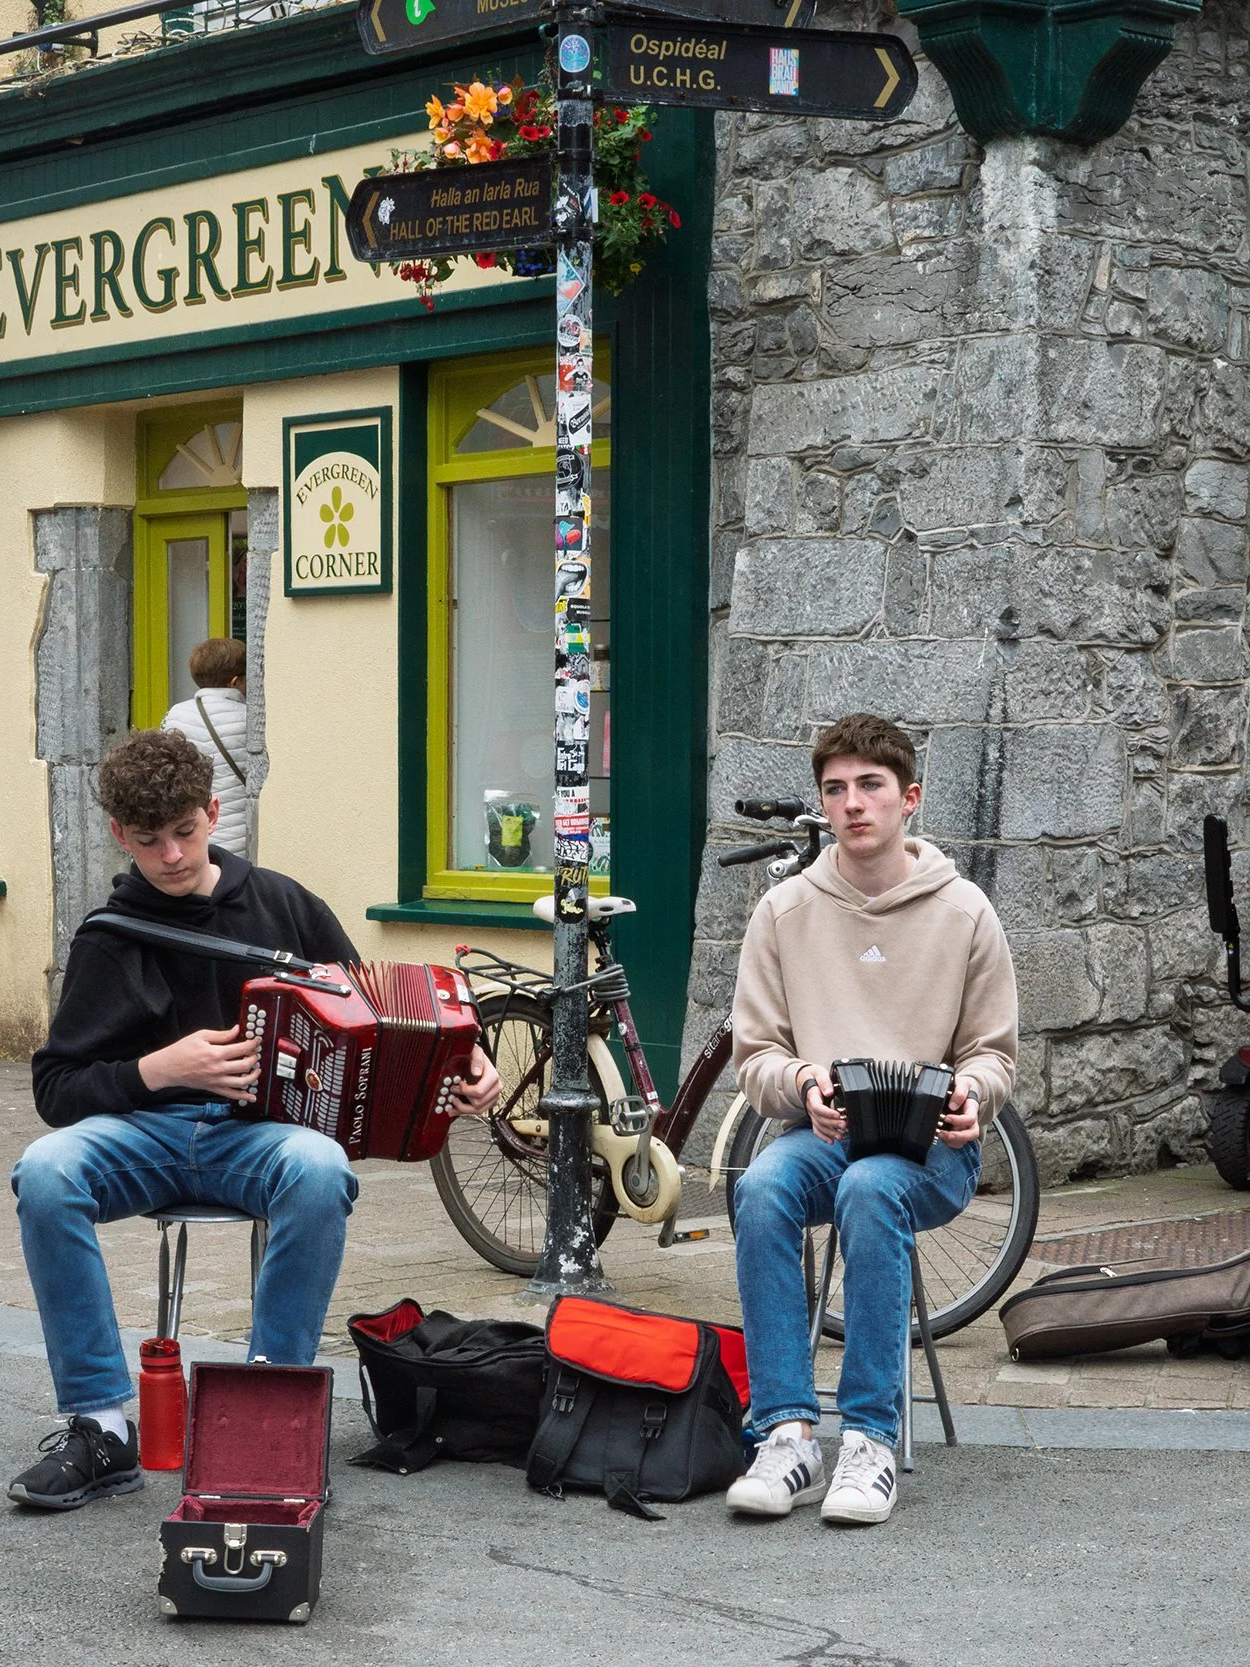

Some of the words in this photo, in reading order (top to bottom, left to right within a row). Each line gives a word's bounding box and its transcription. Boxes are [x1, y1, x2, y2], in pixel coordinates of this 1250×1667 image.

[630, 33, 727, 60] Ospidéal
[630, 64, 721, 91] U.C.H.G.
[431, 188, 461, 208] Halla
[464, 191, 479, 205] an
[515, 178, 539, 197] Rua
[390, 221, 422, 241] HALL
[425, 217, 443, 237] OF
[446, 214, 469, 235] THE
[473, 210, 499, 231] RED
[502, 207, 539, 229] EARL
[295, 464, 379, 506] EVERGREEN
[295, 551, 379, 580] CORNER
[354, 1047, 372, 1100] SOPRANI
[348, 1104, 364, 1144] PAOLO
